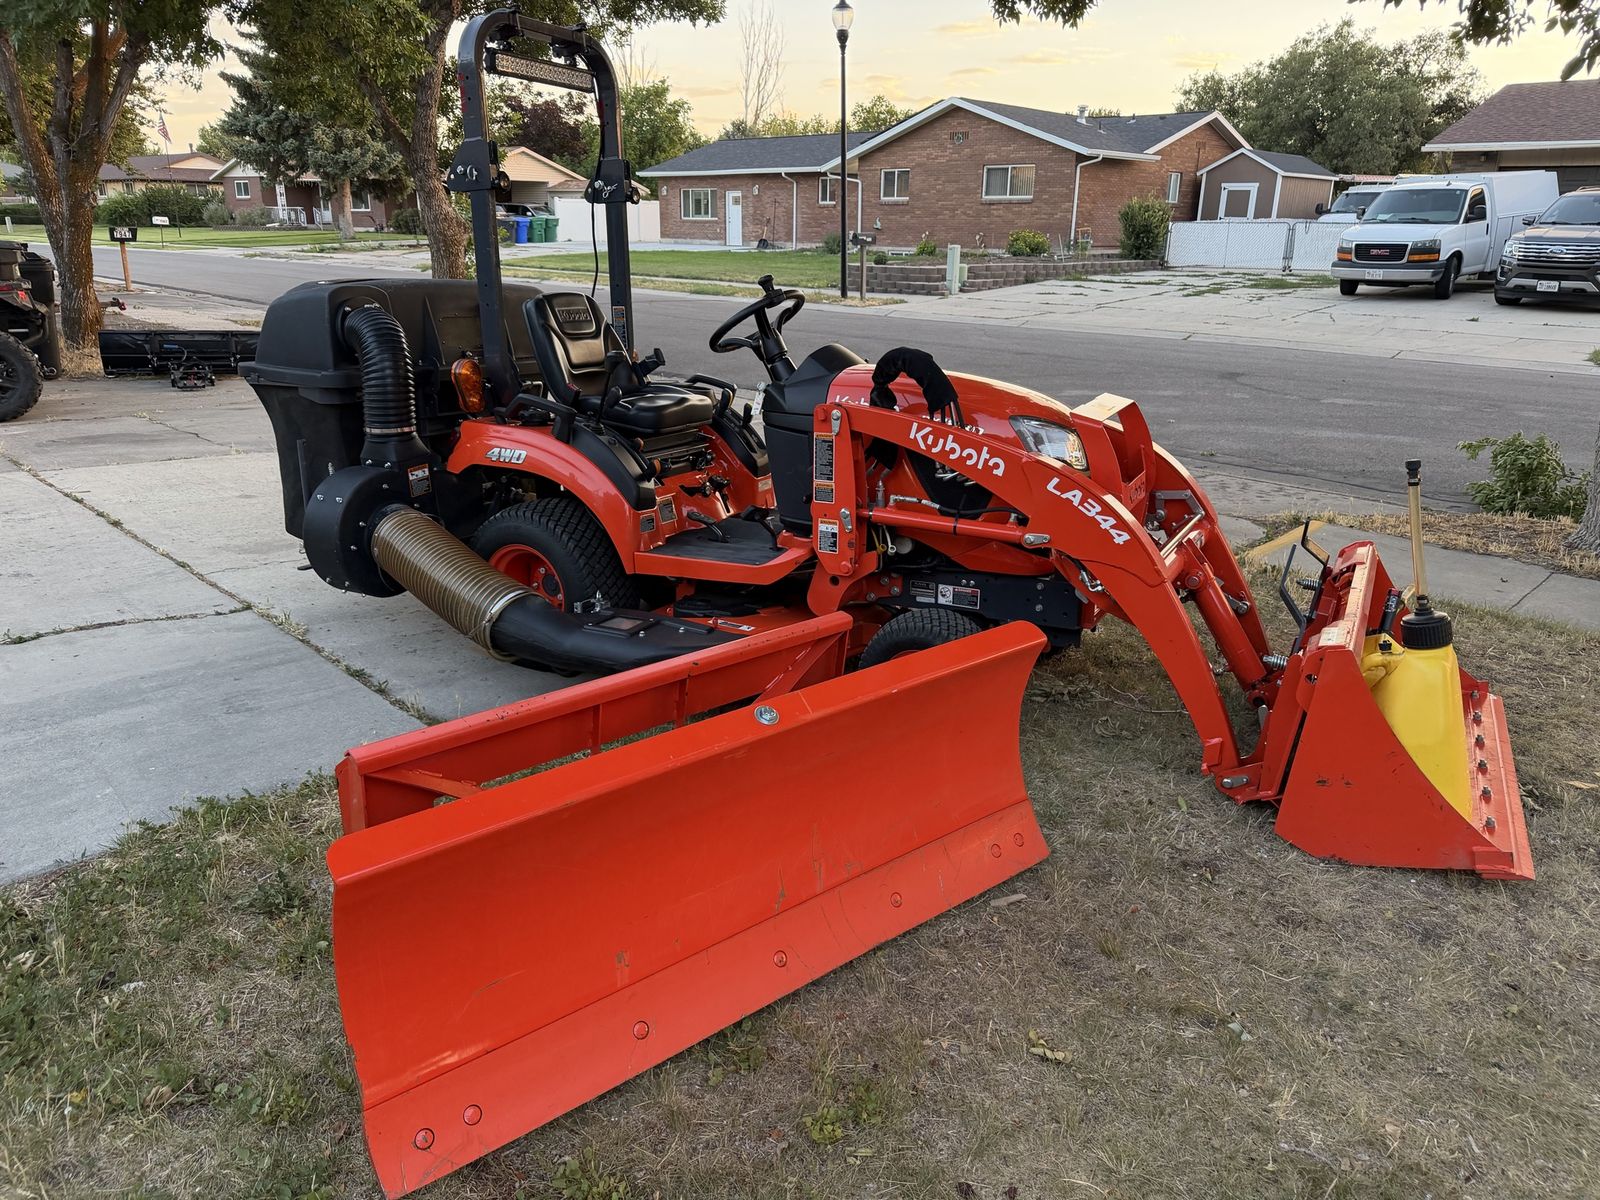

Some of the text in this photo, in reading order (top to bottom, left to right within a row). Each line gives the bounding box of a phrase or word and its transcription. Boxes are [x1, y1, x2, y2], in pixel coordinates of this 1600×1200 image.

[1370, 248, 1390, 256] GMC
[485, 447, 527, 464] 4WD
[909, 421, 1005, 477] Kubota
[1046, 477, 1131, 545] LA344
